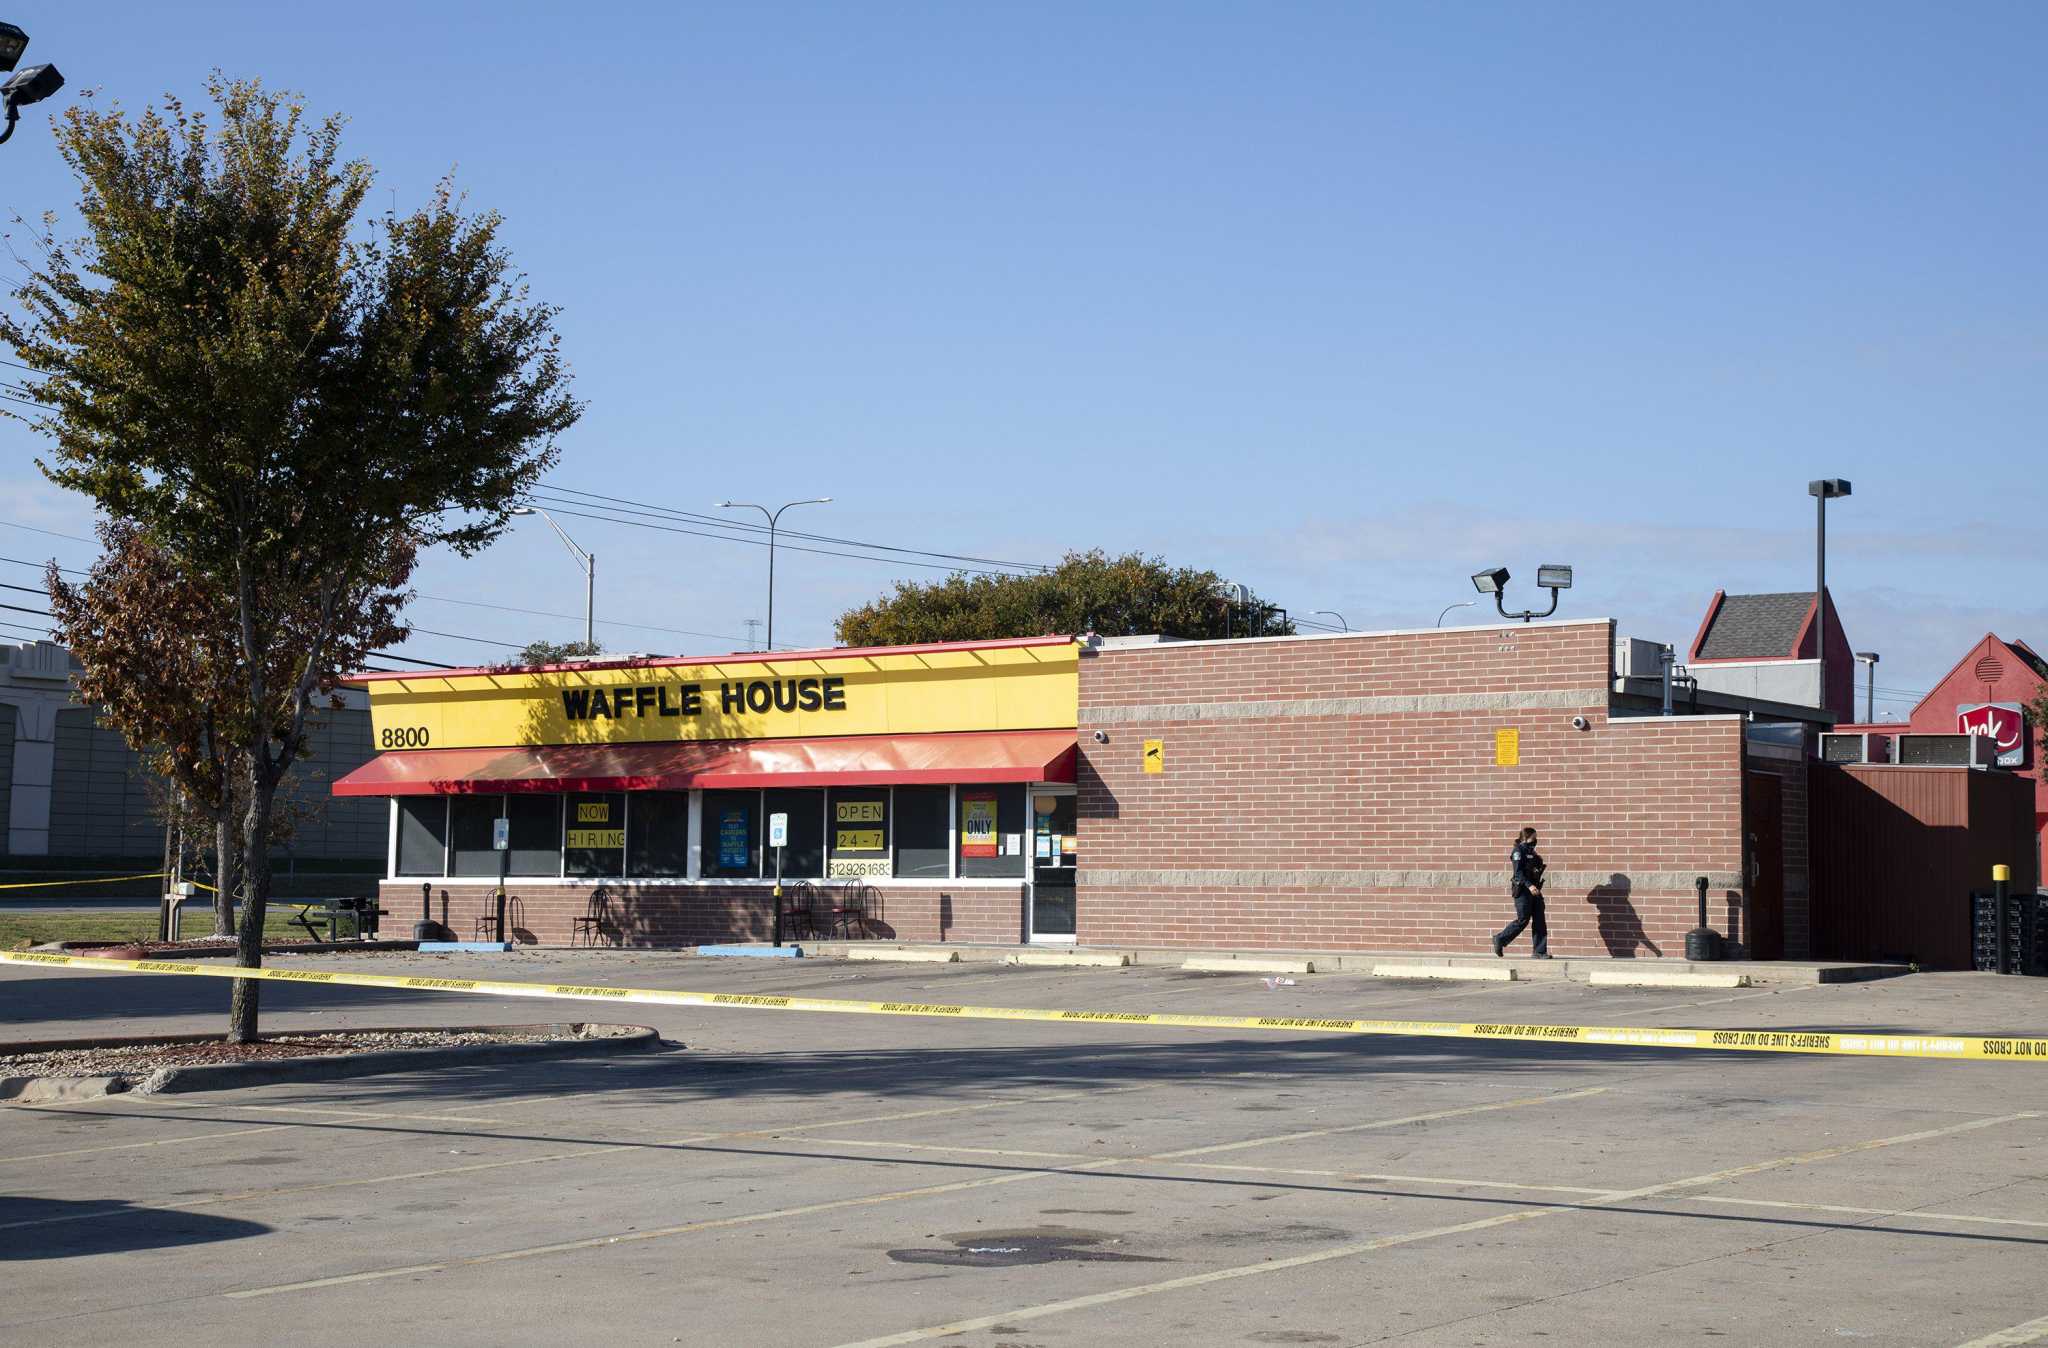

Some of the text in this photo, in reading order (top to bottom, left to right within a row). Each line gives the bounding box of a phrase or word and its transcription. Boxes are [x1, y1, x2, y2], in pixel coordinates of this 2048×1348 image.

[562, 677, 846, 720] WAFFLE HOUSE
[382, 726, 430, 748] 8800
[580, 805, 609, 820] NOW
[838, 806, 881, 819] OPEN
[967, 819, 993, 835] ONLY
[568, 832, 624, 846] HIRING
[1712, 1031, 1830, 1048] SHERIFF'S LINE DO NOT CROSS
[1983, 1040, 2047, 1056] DO NOT CROSS
